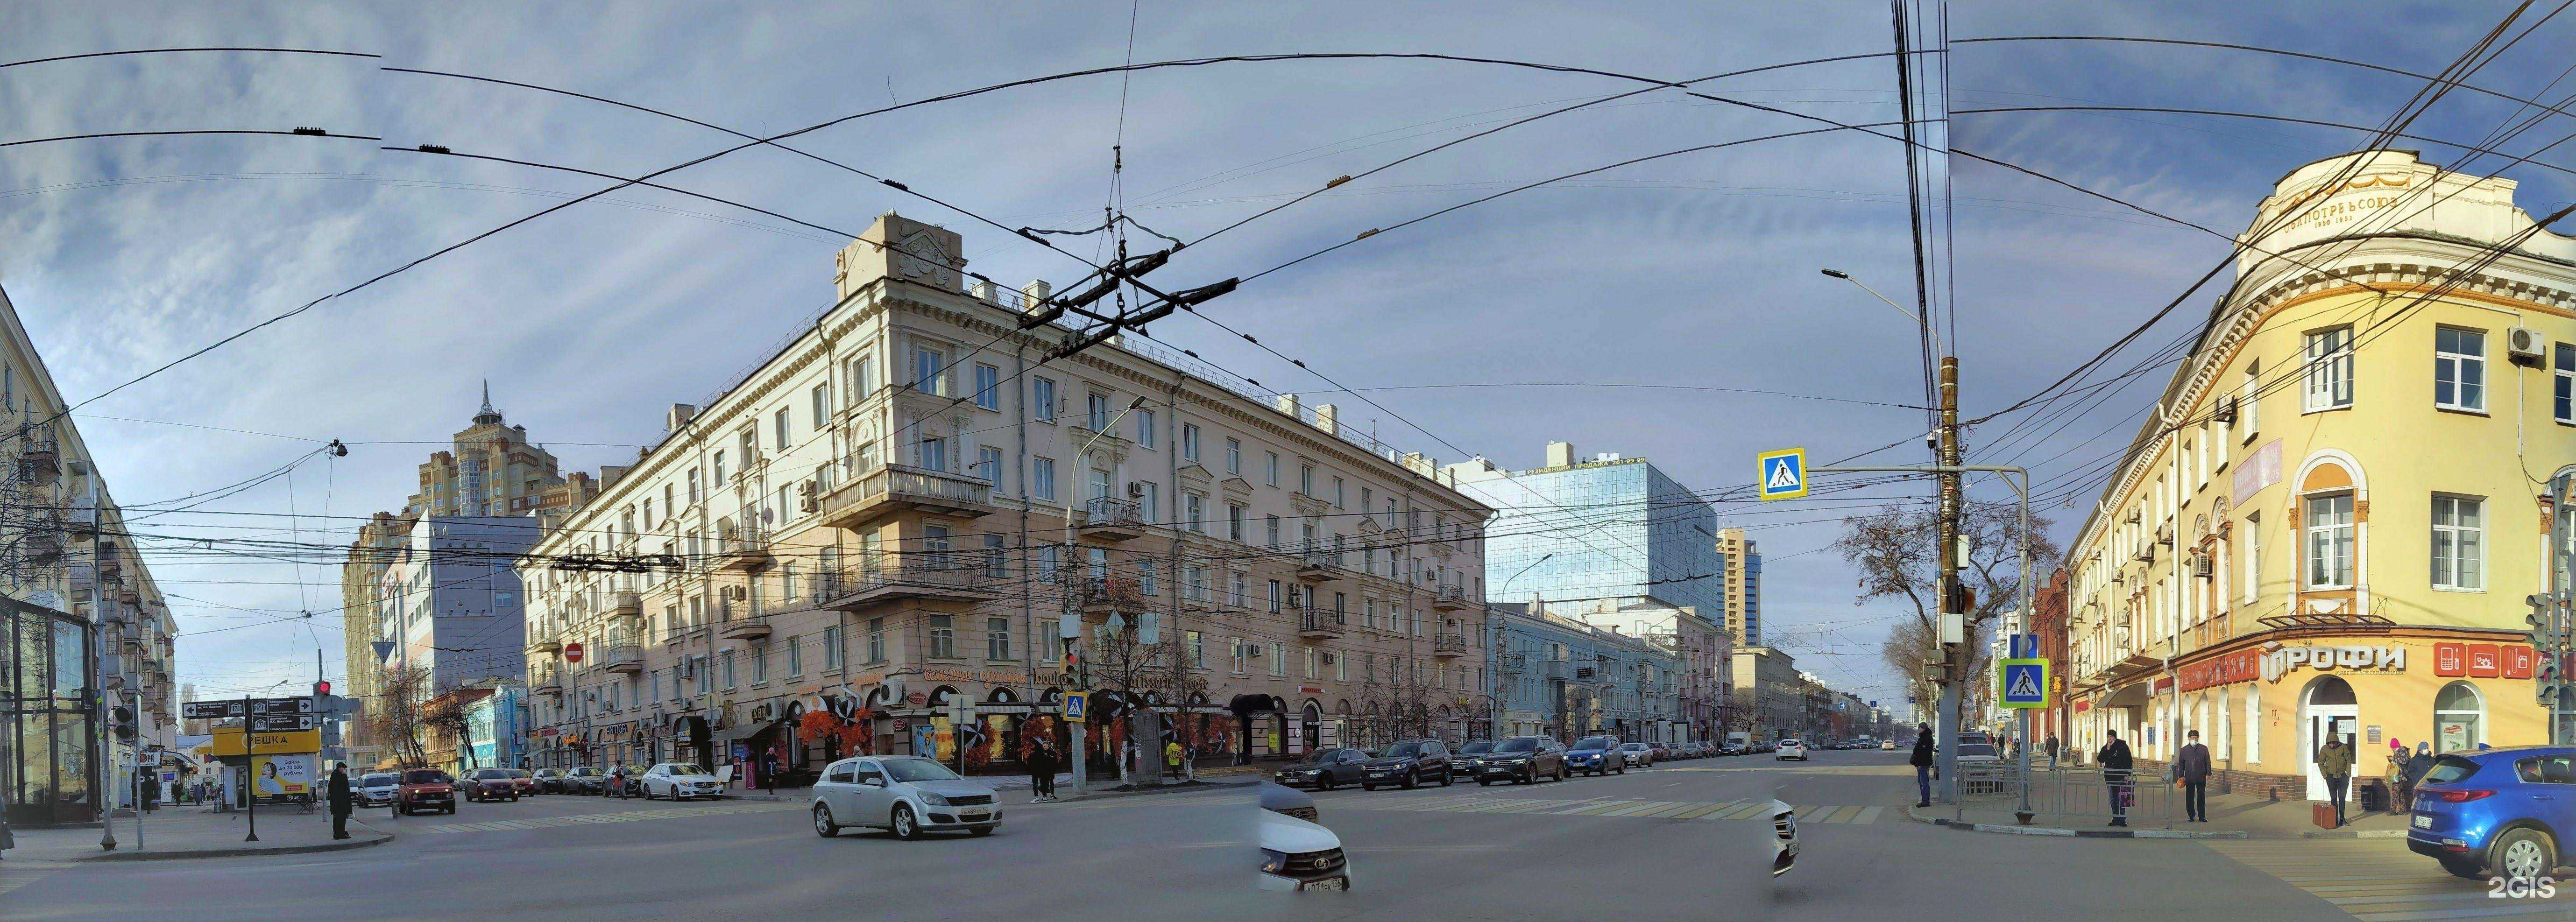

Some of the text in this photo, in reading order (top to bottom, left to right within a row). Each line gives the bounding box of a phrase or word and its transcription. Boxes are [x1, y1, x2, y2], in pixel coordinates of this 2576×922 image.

[1527, 465, 1571, 475] РЕЗИДЕНЦИИ
[1574, 461, 1608, 469] ПРОДАЖА
[2259, 640, 2404, 681] ПРОФИ
[924, 667, 1027, 689] семейная кулинария
